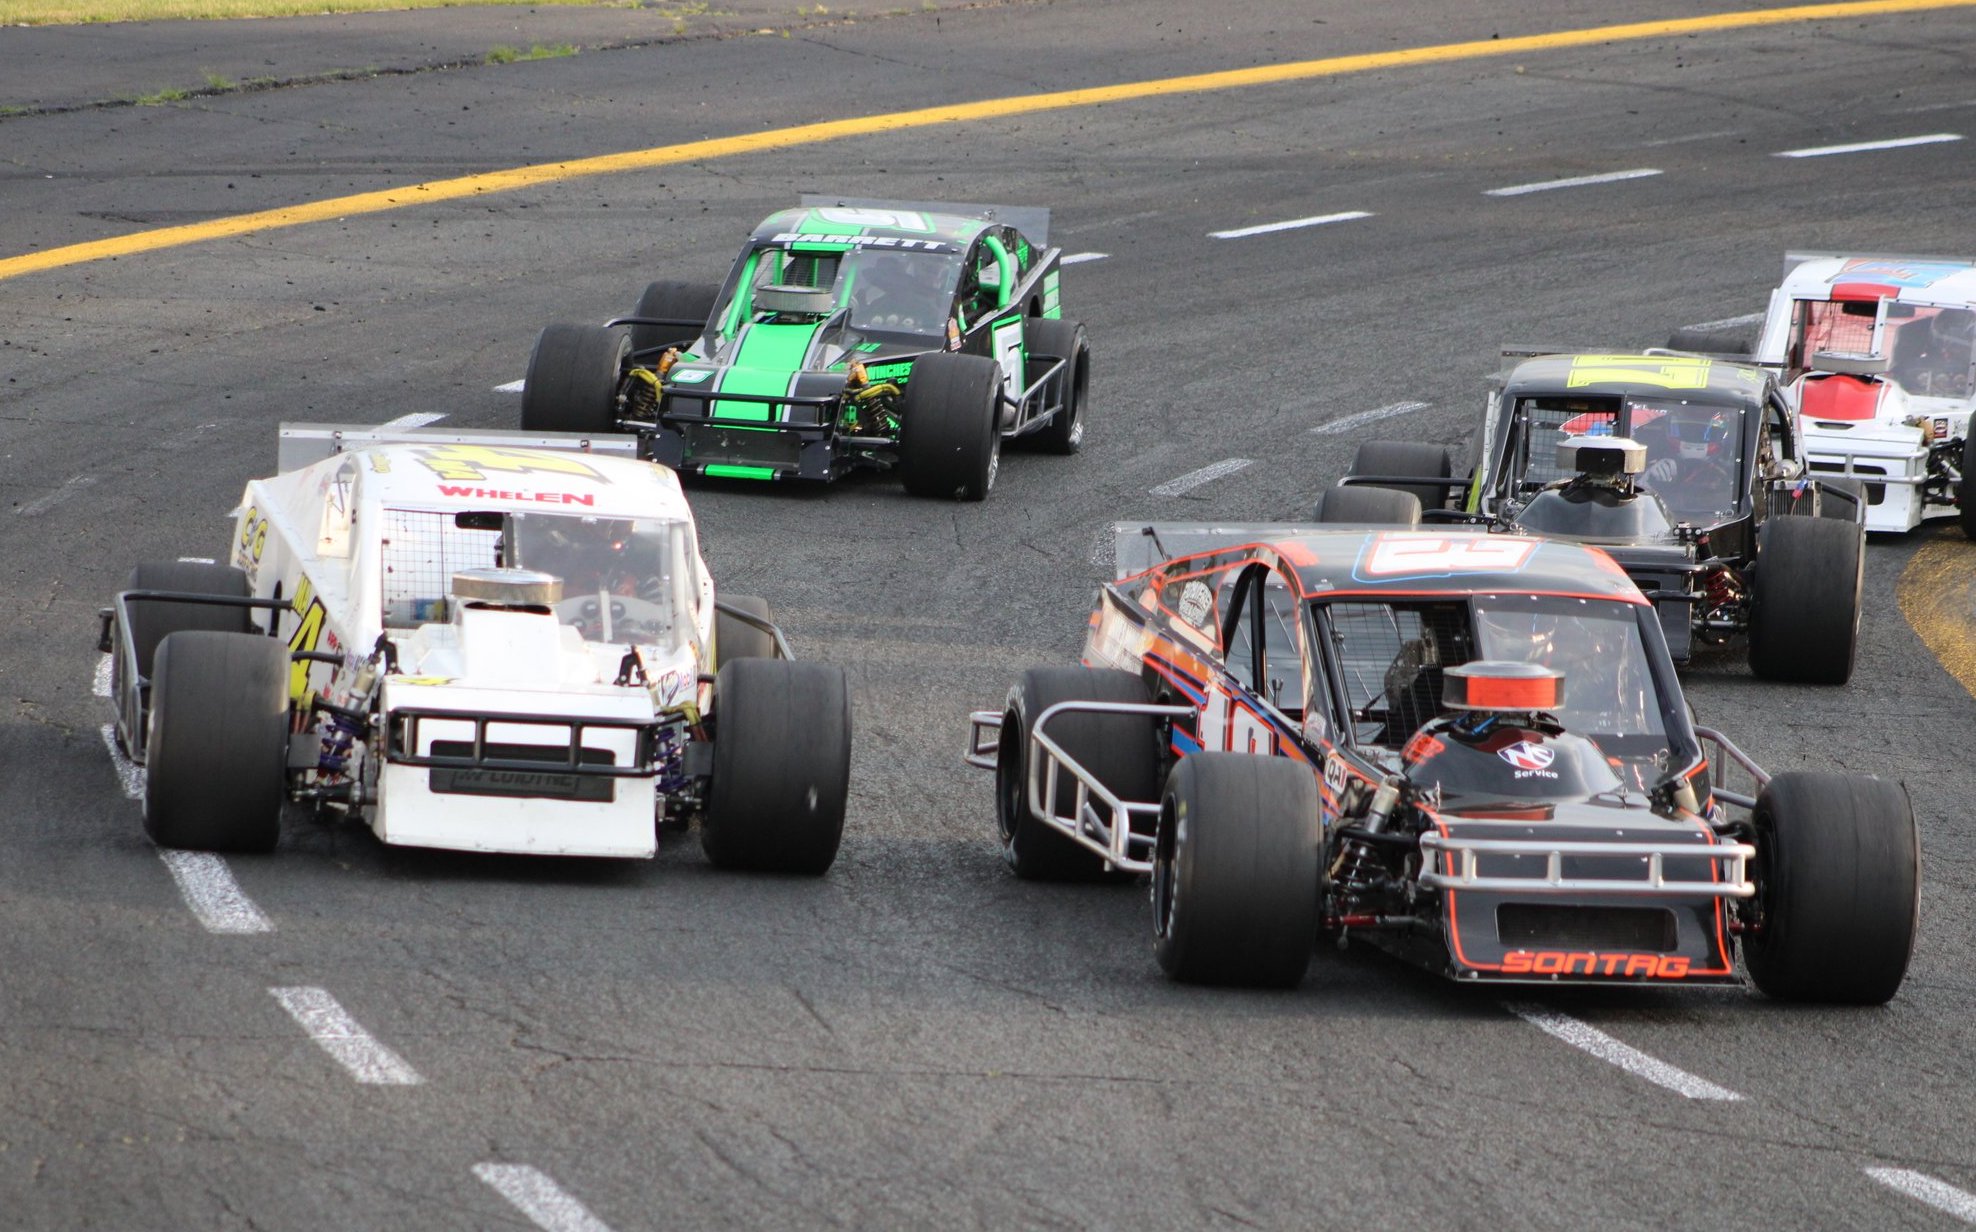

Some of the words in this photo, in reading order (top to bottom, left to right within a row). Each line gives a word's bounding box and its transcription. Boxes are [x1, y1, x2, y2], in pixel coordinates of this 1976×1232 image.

[771, 232, 946, 249] BARRETT
[437, 484, 594, 506] WHELEN
[1514, 769, 1558, 779] Service
[1501, 951, 1690, 978] SONTAG
